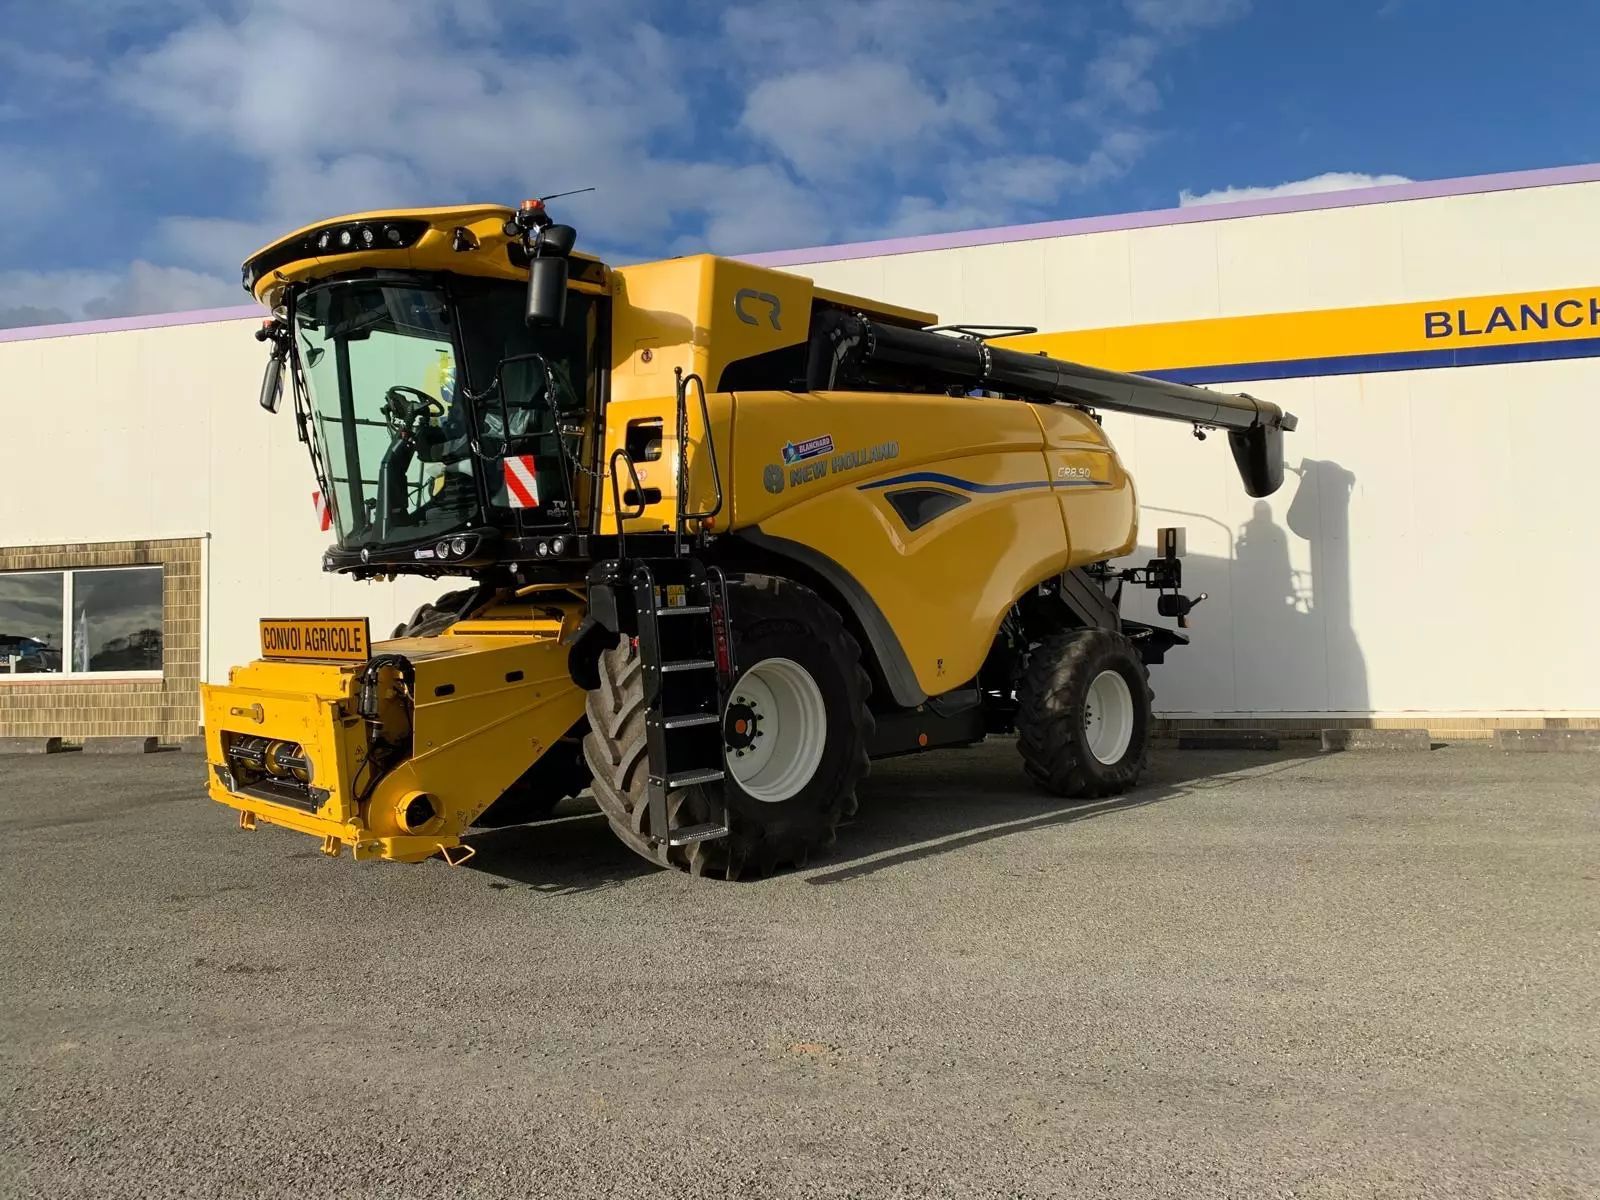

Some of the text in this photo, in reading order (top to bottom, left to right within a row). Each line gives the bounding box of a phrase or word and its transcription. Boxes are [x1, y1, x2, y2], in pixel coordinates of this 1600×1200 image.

[735, 288, 782, 331] CR
[798, 437, 831, 454] BLANCHARD
[789, 440, 899, 488] NEW HOLLAND
[263, 627, 362, 653] CONVOI AGRICOLE
